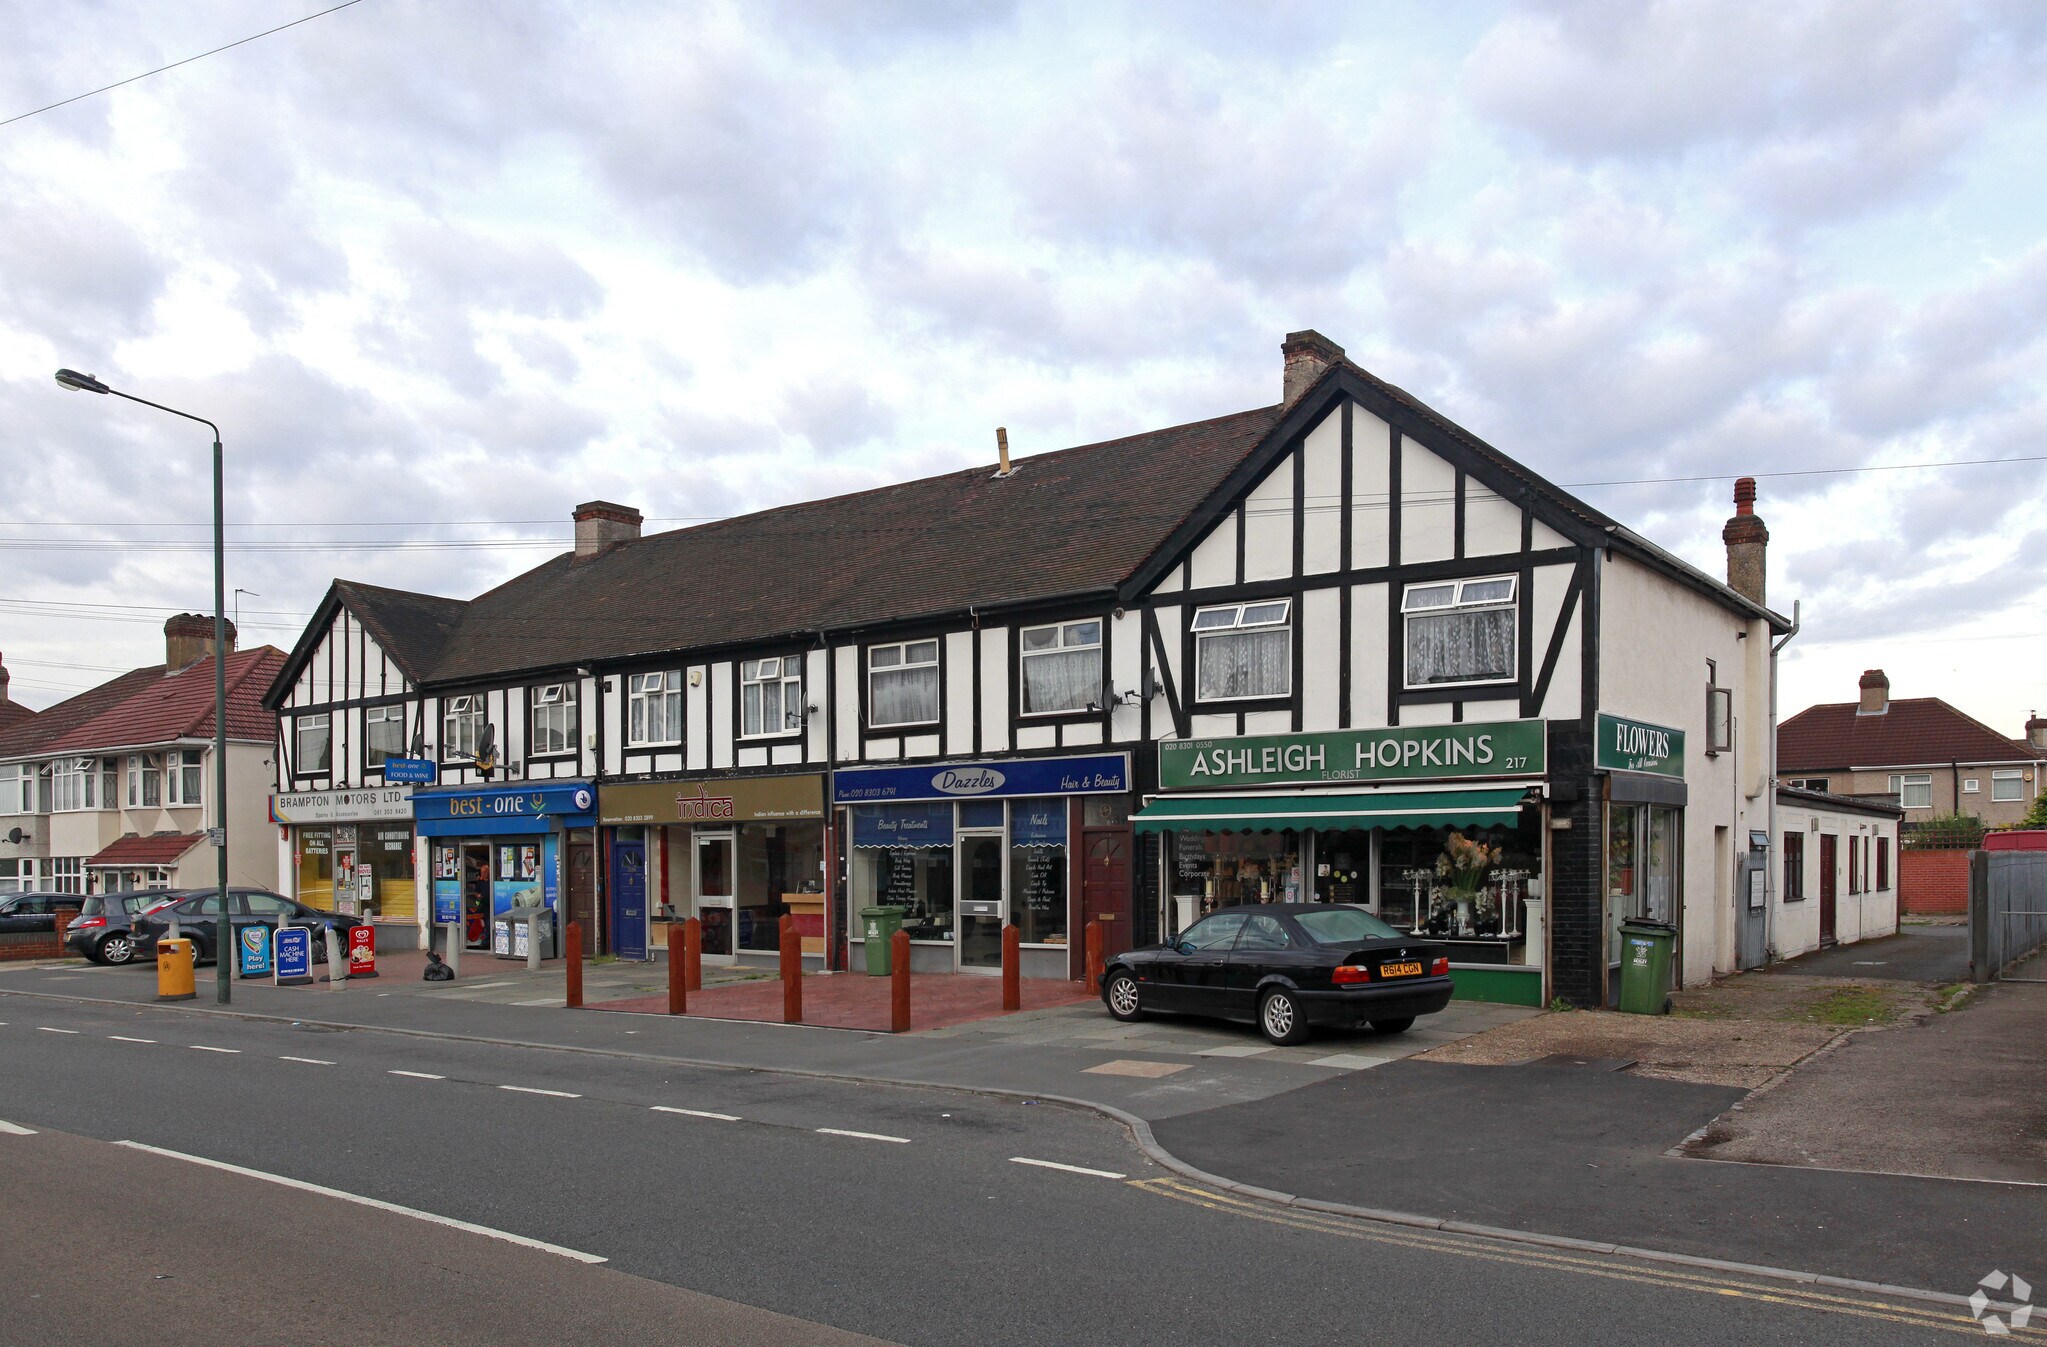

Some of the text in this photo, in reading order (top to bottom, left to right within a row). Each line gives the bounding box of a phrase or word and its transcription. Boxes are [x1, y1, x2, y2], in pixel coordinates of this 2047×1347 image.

[1196, 741, 1212, 749] 0550
[1615, 723, 1669, 758] FLOWERS
[1190, 734, 1494, 776] ASHLEIGH HOPKINS
[1505, 757, 1527, 769] 217
[942, 769, 995, 789] Dazzles
[1321, 769, 1361, 781] FLORIST
[1060, 774, 1120, 790] Hair & Beauty
[850, 789, 863, 797] 020
[864, 788, 880, 796] 8303
[882, 787, 896, 795] 6791
[280, 791, 401, 808] BRAMPTON MOTORS LTD
[676, 783, 735, 818] indica
[877, 818, 929, 832] Beauty Treatments
[1030, 813, 1048, 826] Nails
[1179, 862, 1197, 870] Events
[1179, 871, 1210, 880] Corporate
[248, 955, 264, 963] Play
[279, 950, 305, 958] MACHINE
[246, 962, 265, 971] here!
[1383, 963, 1419, 976] R614 CGN
